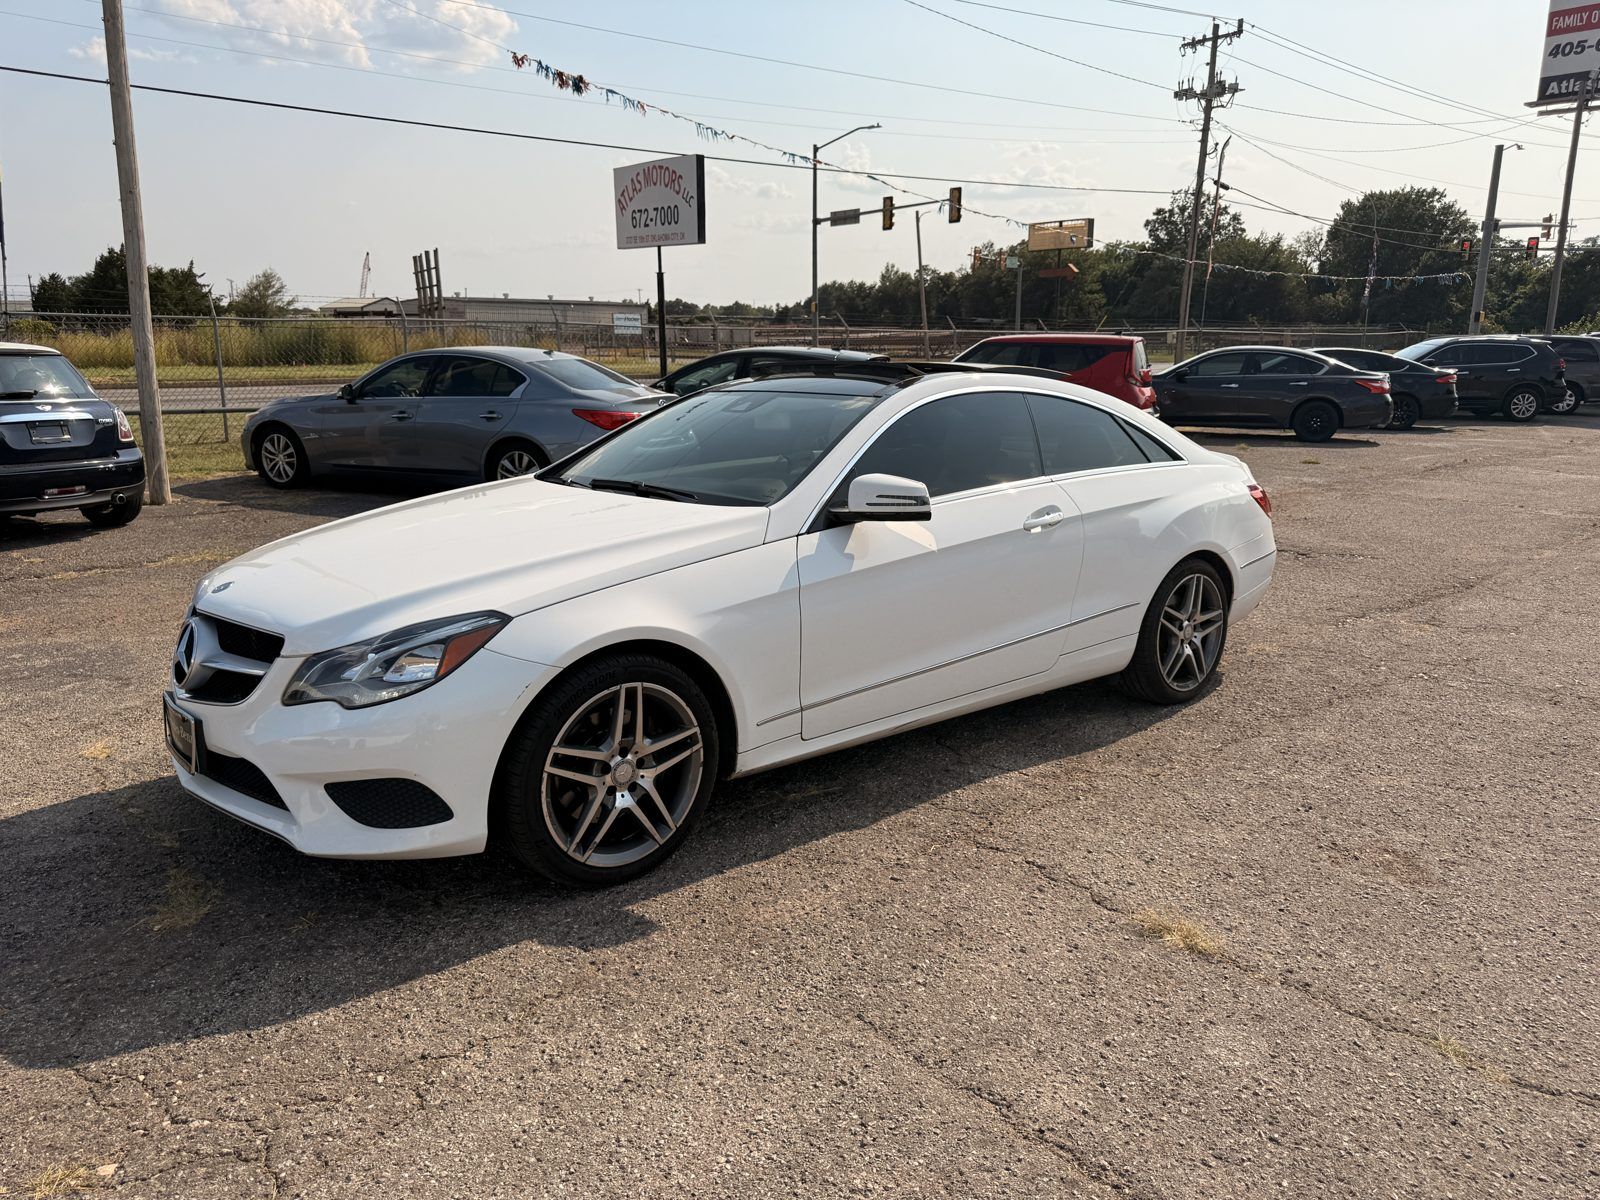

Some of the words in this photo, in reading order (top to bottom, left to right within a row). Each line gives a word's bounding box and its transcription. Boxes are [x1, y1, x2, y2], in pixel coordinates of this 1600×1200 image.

[1552, 11, 1589, 30] FAMILY
[617, 172, 642, 217] ATLAS
[643, 165, 683, 195] MOTORS
[682, 187, 694, 208] LLC
[631, 204, 680, 229] 672-7000
